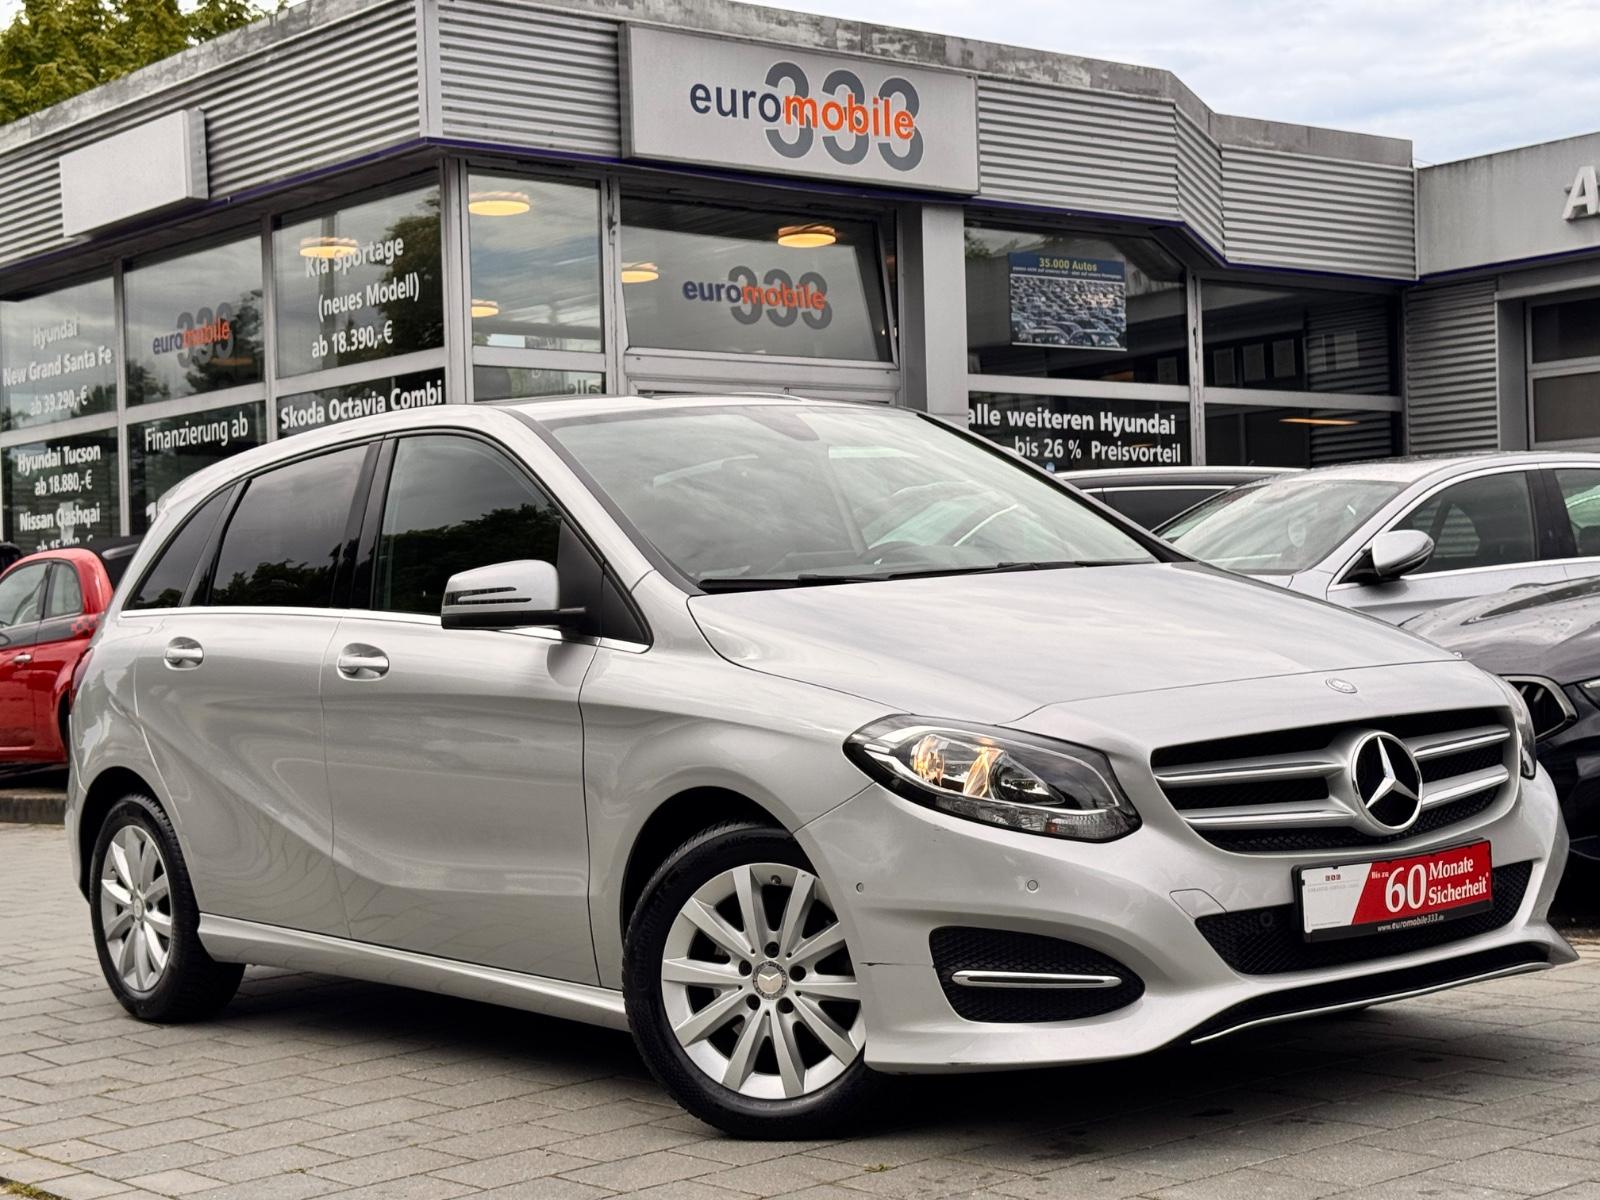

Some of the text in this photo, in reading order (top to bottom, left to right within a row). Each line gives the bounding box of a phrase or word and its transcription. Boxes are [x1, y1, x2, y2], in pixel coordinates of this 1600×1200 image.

[689, 82, 914, 140] euromobile
[764, 61, 924, 172] 333
[1561, 165, 1600, 219] A
[334, 237, 404, 276] Sportage
[1039, 257, 1097, 272] 35.000 Autos
[318, 272, 420, 322] (neues Modell)
[682, 280, 825, 310] euromobile
[728, 265, 832, 330] 333
[33, 318, 77, 350] Hyundai
[312, 335, 328, 358] ab
[3, 345, 112, 387] New Grand Santa Fe
[31, 394, 42, 416] ab
[281, 380, 443, 430] Skoda Octavia Combi
[968, 403, 1175, 437] alle weiteren Hyundai
[145, 411, 249, 452] Finanzierung ab
[18, 445, 101, 476] Hyundai Tucson
[1015, 436, 1181, 463] bis 26 % Preisvorteil
[35, 476, 47, 496] ab
[20, 502, 101, 532] Nissan Qashqai
[1428, 856, 1474, 880] Monate
[1385, 864, 1427, 913] 60
